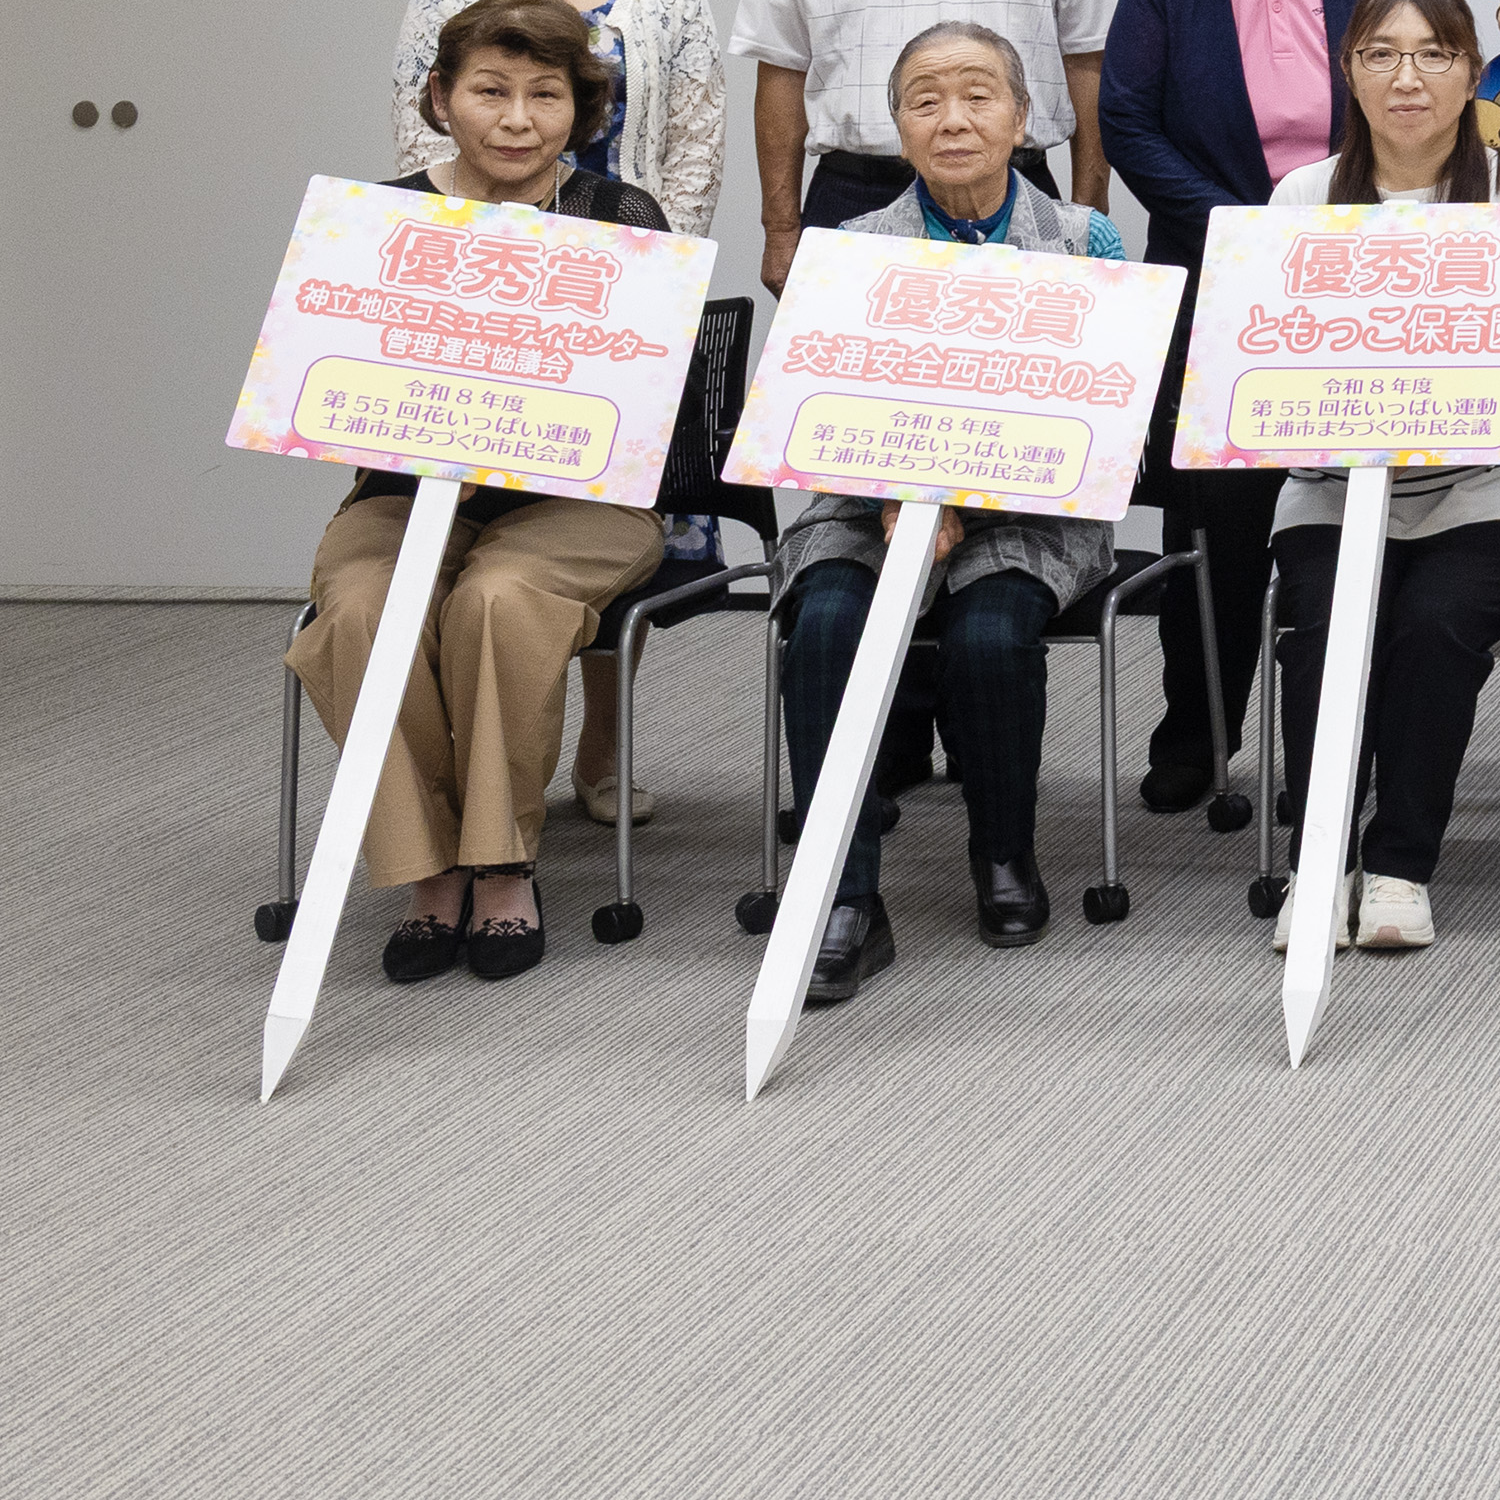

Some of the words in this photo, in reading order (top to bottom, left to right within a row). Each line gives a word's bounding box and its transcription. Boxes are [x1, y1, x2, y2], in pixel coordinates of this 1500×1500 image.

[378, 218, 622, 319] 優秀賞
[297, 279, 669, 363] 神立地区コミュニティセンター
[866, 263, 1095, 349] 優秀賞
[381, 323, 572, 384] 管理運営協議会
[783, 331, 1136, 407] 交通安全西部母の会
[319, 413, 583, 468] 土浦市まちづくり市民会議
[1252, 418, 1492, 438] 土浦市まちづくり市民会議
[808, 445, 1057, 485] 土浦市まちづくり市民会議
